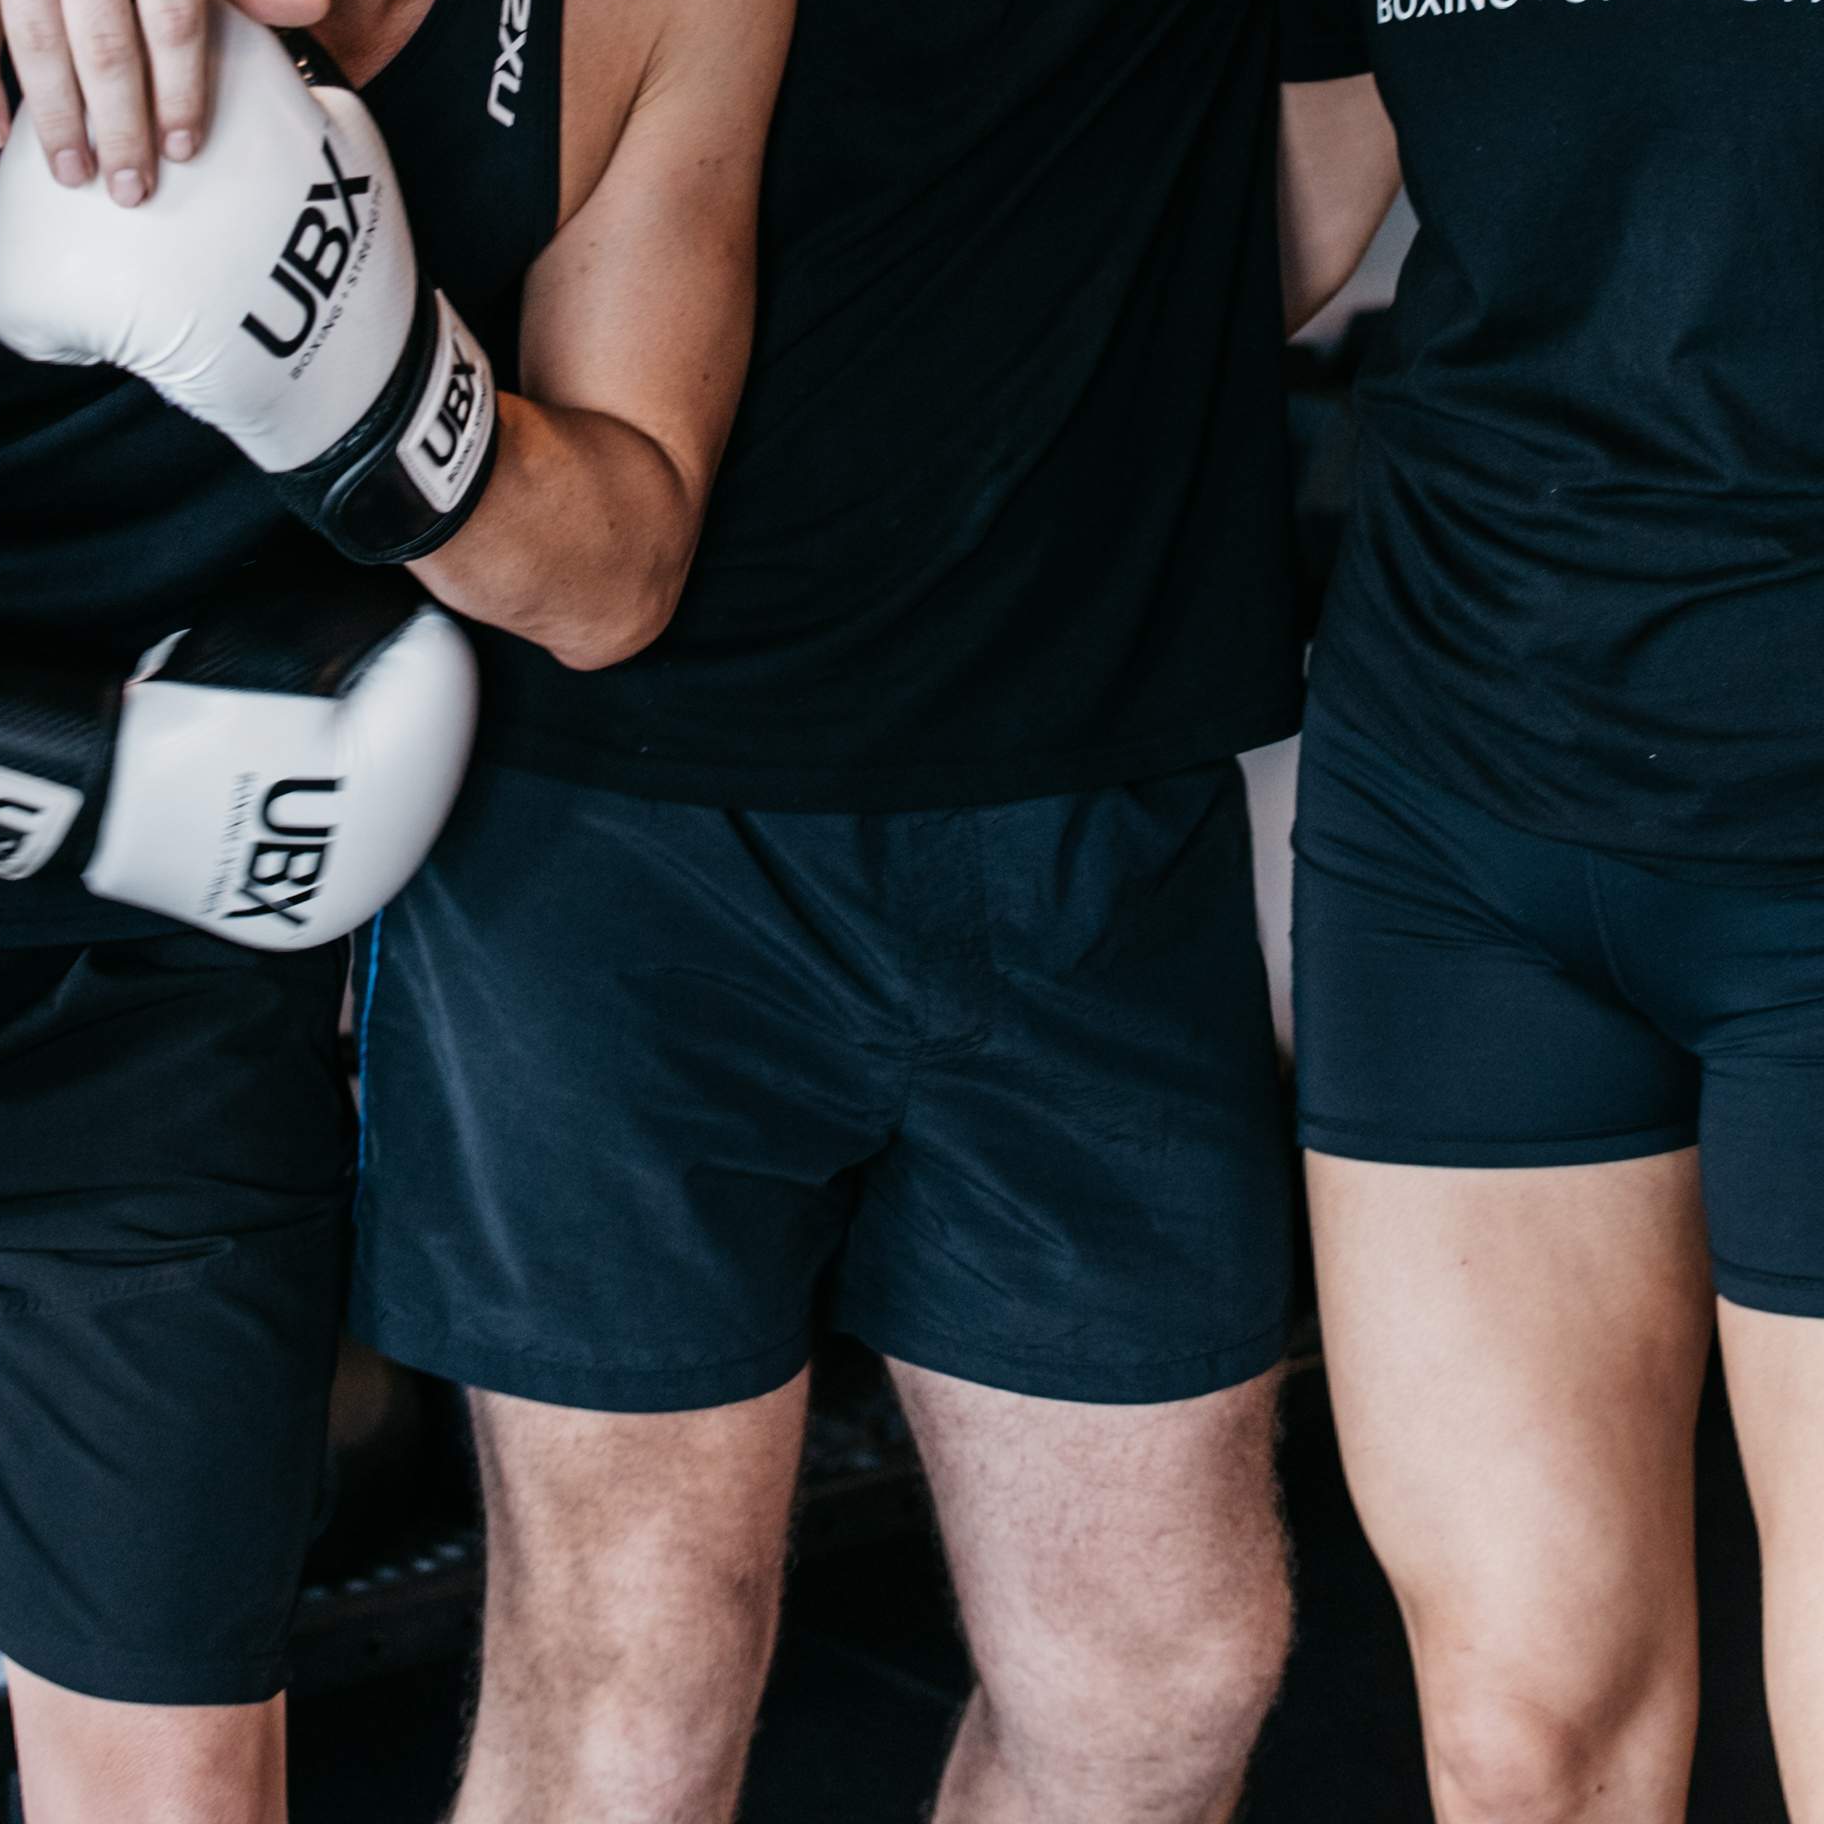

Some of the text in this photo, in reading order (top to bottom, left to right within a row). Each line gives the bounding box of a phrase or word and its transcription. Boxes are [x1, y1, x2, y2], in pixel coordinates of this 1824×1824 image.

[240, 136, 372, 360] UBX
[419, 334, 478, 469] UBX
[222, 777, 342, 928] UBX
